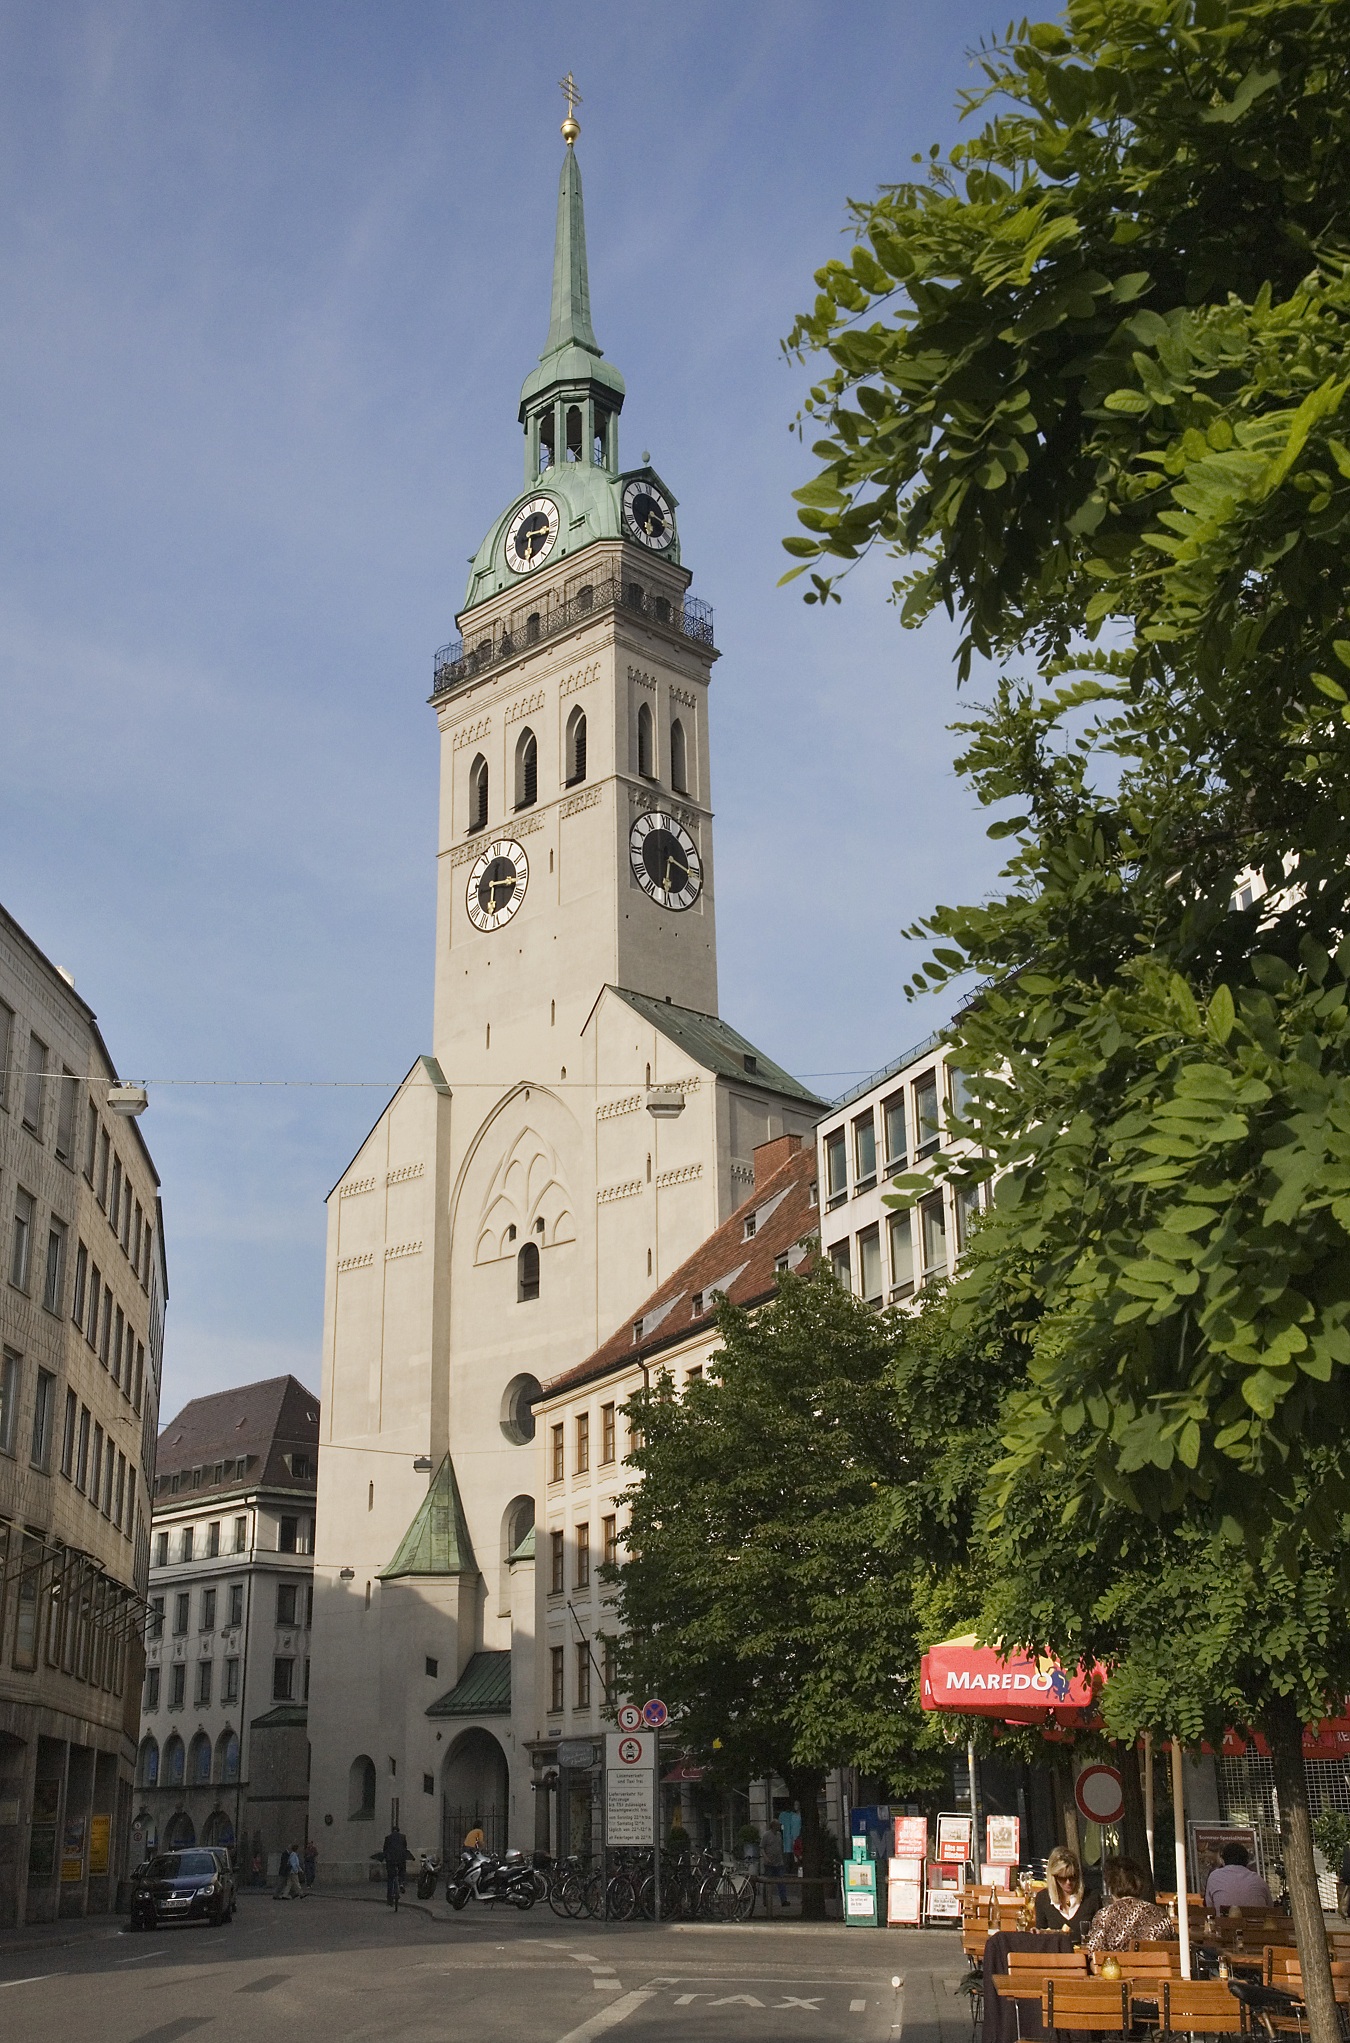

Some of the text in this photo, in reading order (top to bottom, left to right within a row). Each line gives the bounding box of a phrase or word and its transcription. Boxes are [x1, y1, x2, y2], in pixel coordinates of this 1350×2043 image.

[946, 1671, 1053, 1690] MAREDO
[626, 1712, 634, 1725] 5
[669, 1993, 866, 2012] TAXI
